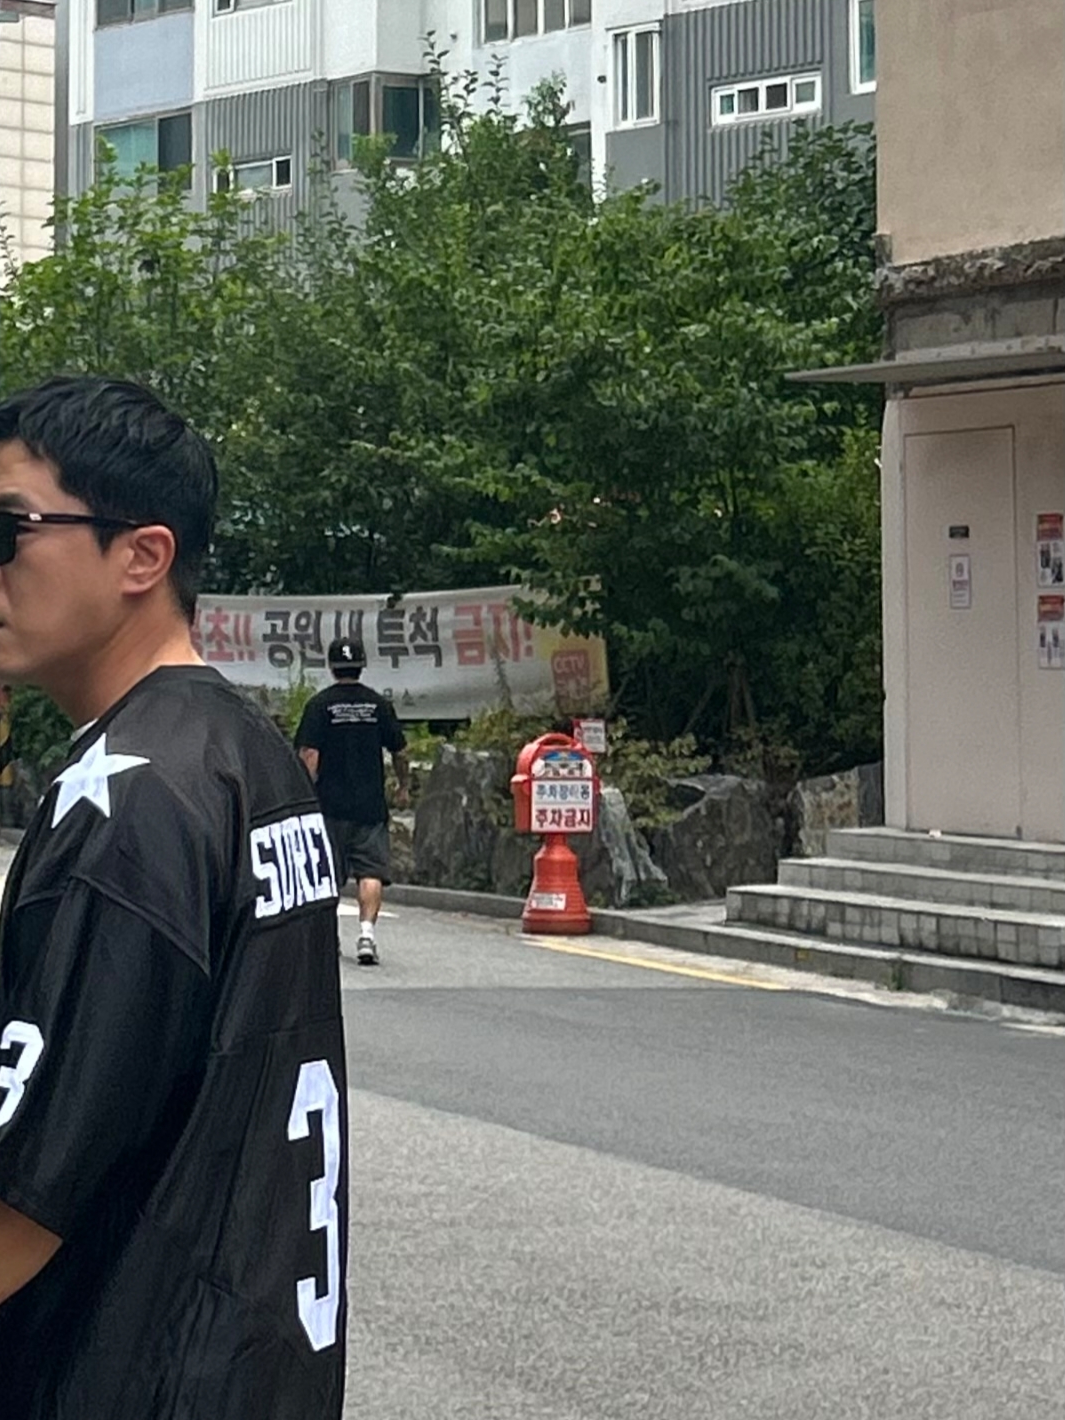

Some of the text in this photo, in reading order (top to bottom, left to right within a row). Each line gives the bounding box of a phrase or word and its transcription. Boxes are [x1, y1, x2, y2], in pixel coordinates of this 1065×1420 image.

[262, 611, 326, 668] 공원
[377, 606, 442, 668] 투척
[536, 808, 590, 829] 주차금지
[250, 812, 338, 919] SURE
[287, 1059, 339, 1351] 3
